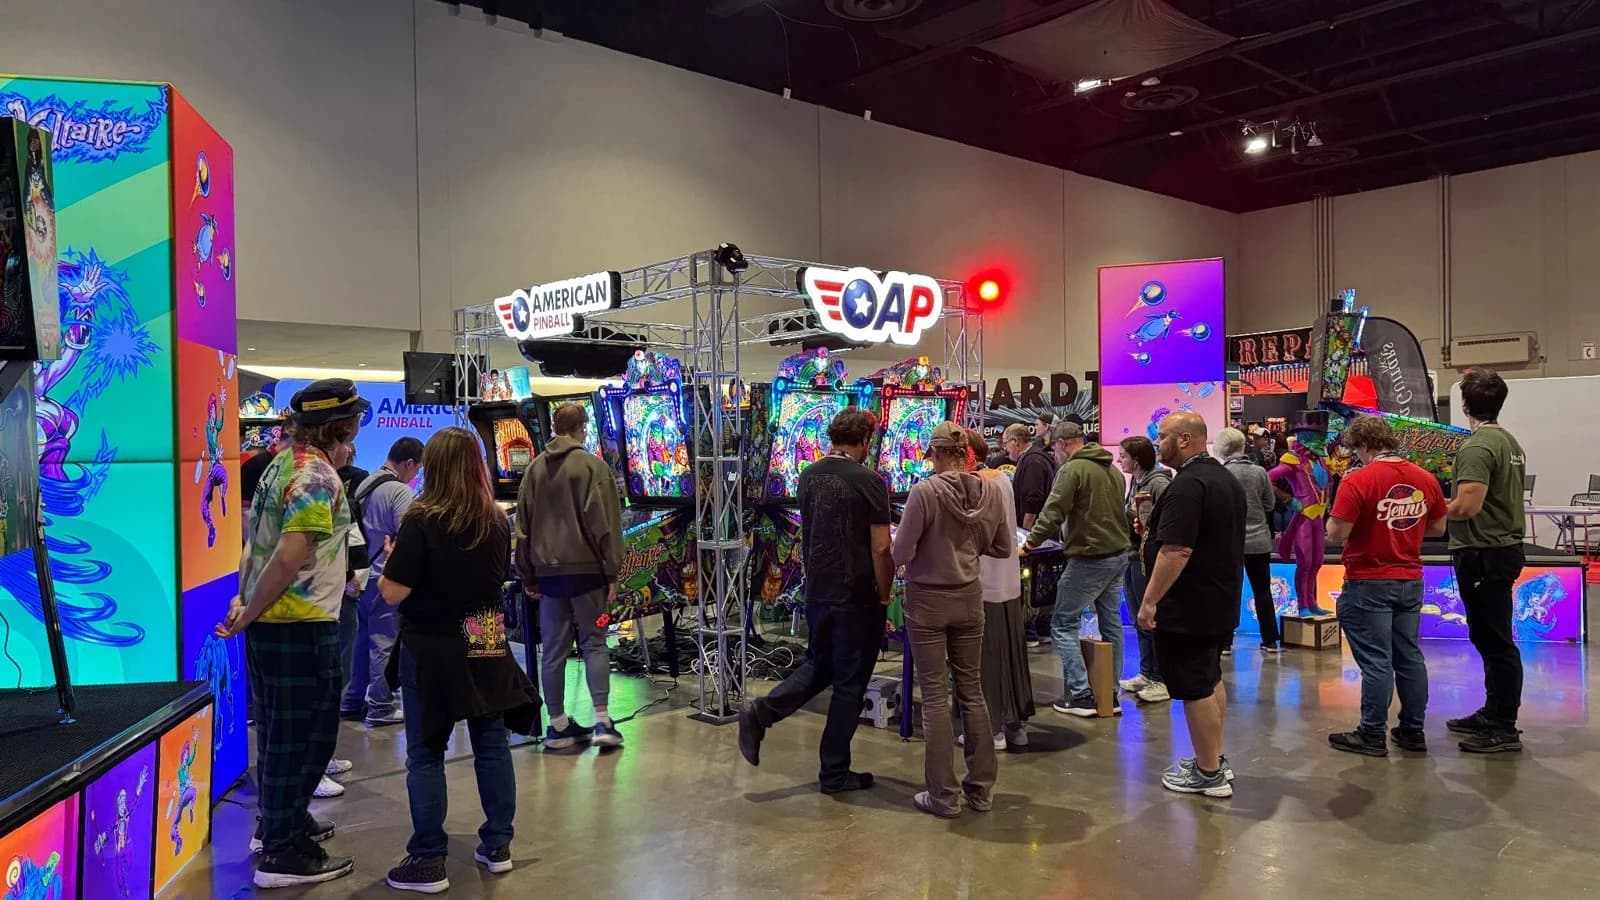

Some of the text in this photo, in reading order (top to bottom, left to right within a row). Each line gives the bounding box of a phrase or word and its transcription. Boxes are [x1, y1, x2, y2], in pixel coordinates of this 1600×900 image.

[532, 280, 607, 313] AMERICAN
[533, 312, 570, 331] PINBALL
[377, 416, 433, 428] PINBALL
